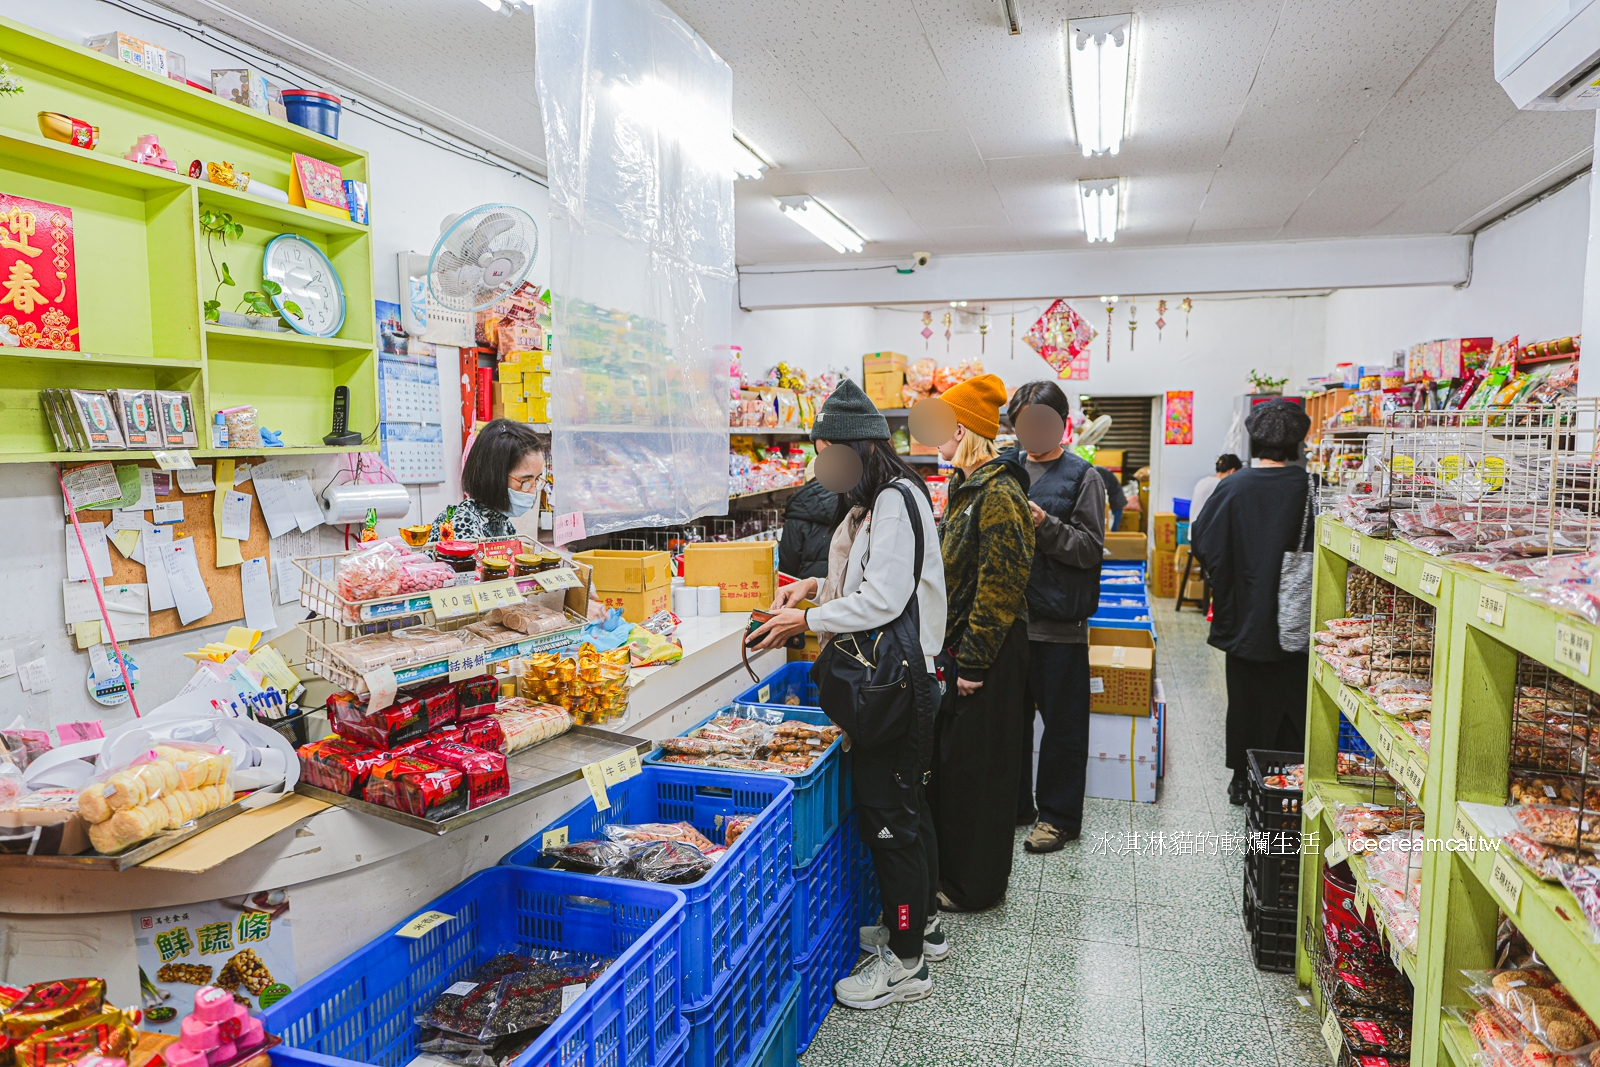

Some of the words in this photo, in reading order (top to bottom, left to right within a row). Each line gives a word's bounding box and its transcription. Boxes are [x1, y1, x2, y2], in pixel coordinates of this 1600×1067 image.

[0, 206, 49, 314] 迎春
[385, 367, 393, 375] 12
[718, 581, 760, 591] 統一發票
[478, 586, 517, 603] 桂花醬
[377, 604, 398, 613] Extra
[533, 639, 571, 653] DOUBLEMINT
[449, 653, 485, 673] 話梅餅
[395, 670, 418, 680] Extra
[155, 913, 270, 961] 鮮蔬條
